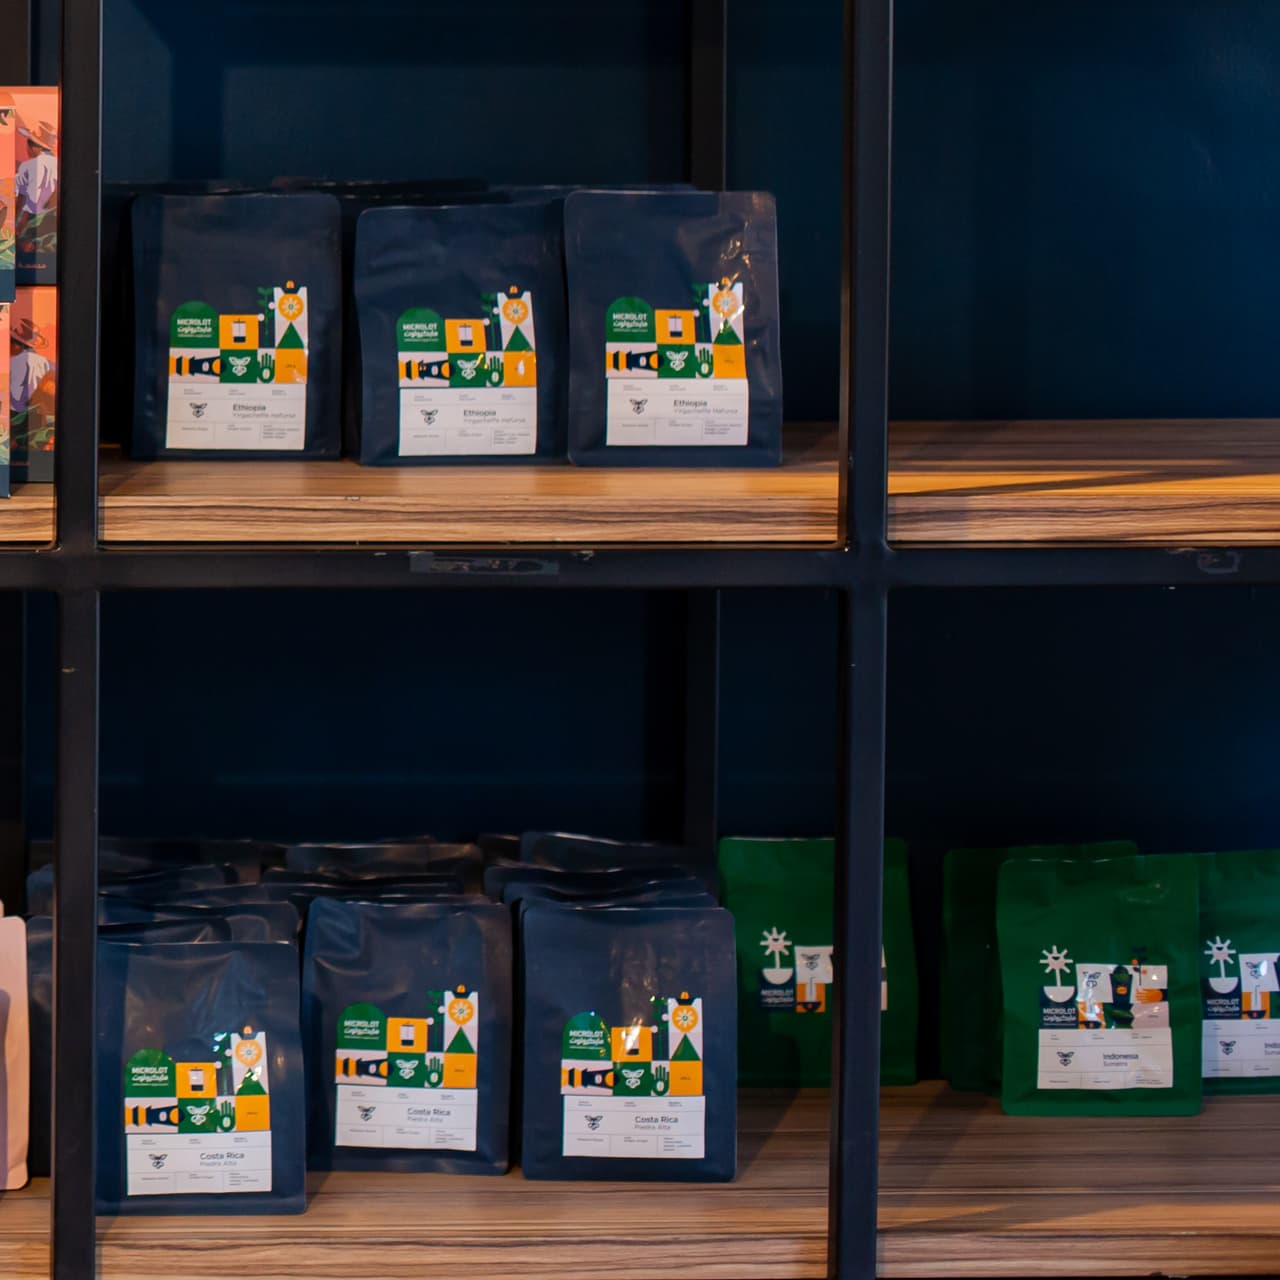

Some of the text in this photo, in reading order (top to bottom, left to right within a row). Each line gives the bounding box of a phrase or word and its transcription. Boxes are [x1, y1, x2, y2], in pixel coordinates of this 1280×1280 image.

[233, 403, 267, 412] Ethiopia
[673, 399, 708, 408] Ethiopia
[463, 409, 497, 418] Ethiopia
[1043, 1007, 1077, 1015] MICROLOT
[132, 1066, 169, 1074] MICROLOT
[407, 1107, 451, 1116] Costa Rica
[634, 1115, 679, 1123] Costa Rica
[199, 1152, 245, 1161] Costa Rica
